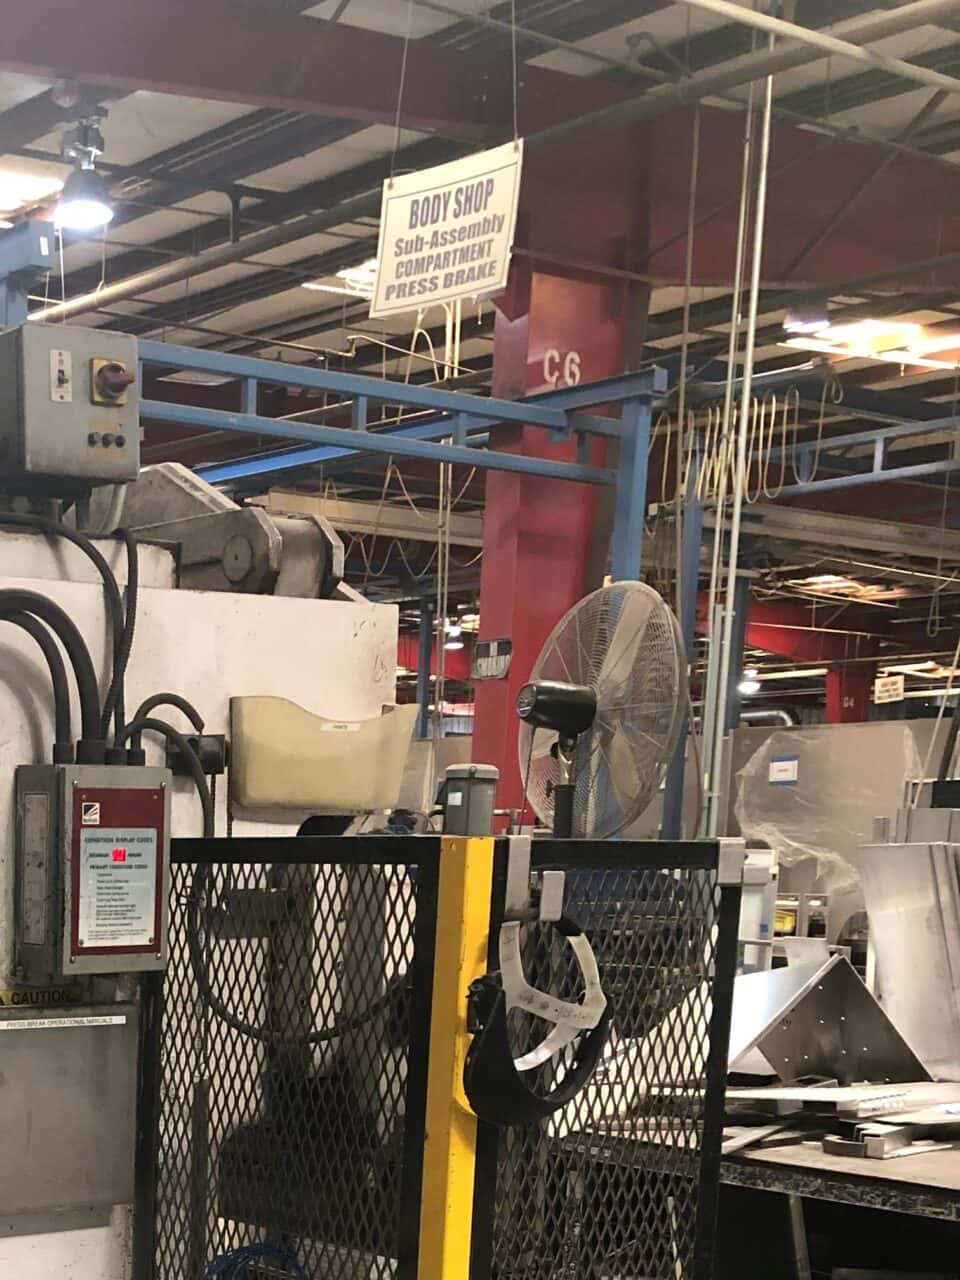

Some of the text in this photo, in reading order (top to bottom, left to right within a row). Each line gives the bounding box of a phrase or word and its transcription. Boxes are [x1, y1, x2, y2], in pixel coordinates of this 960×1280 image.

[408, 178, 495, 229] BODY SHOP
[394, 213, 506, 257] Sub-Assembly
[395, 239, 495, 279] COMPARTMENT
[384, 260, 497, 301] PRESS BRAKE
[543, 349, 581, 386] C6
[11, 989, 70, 1005] CAUTION
